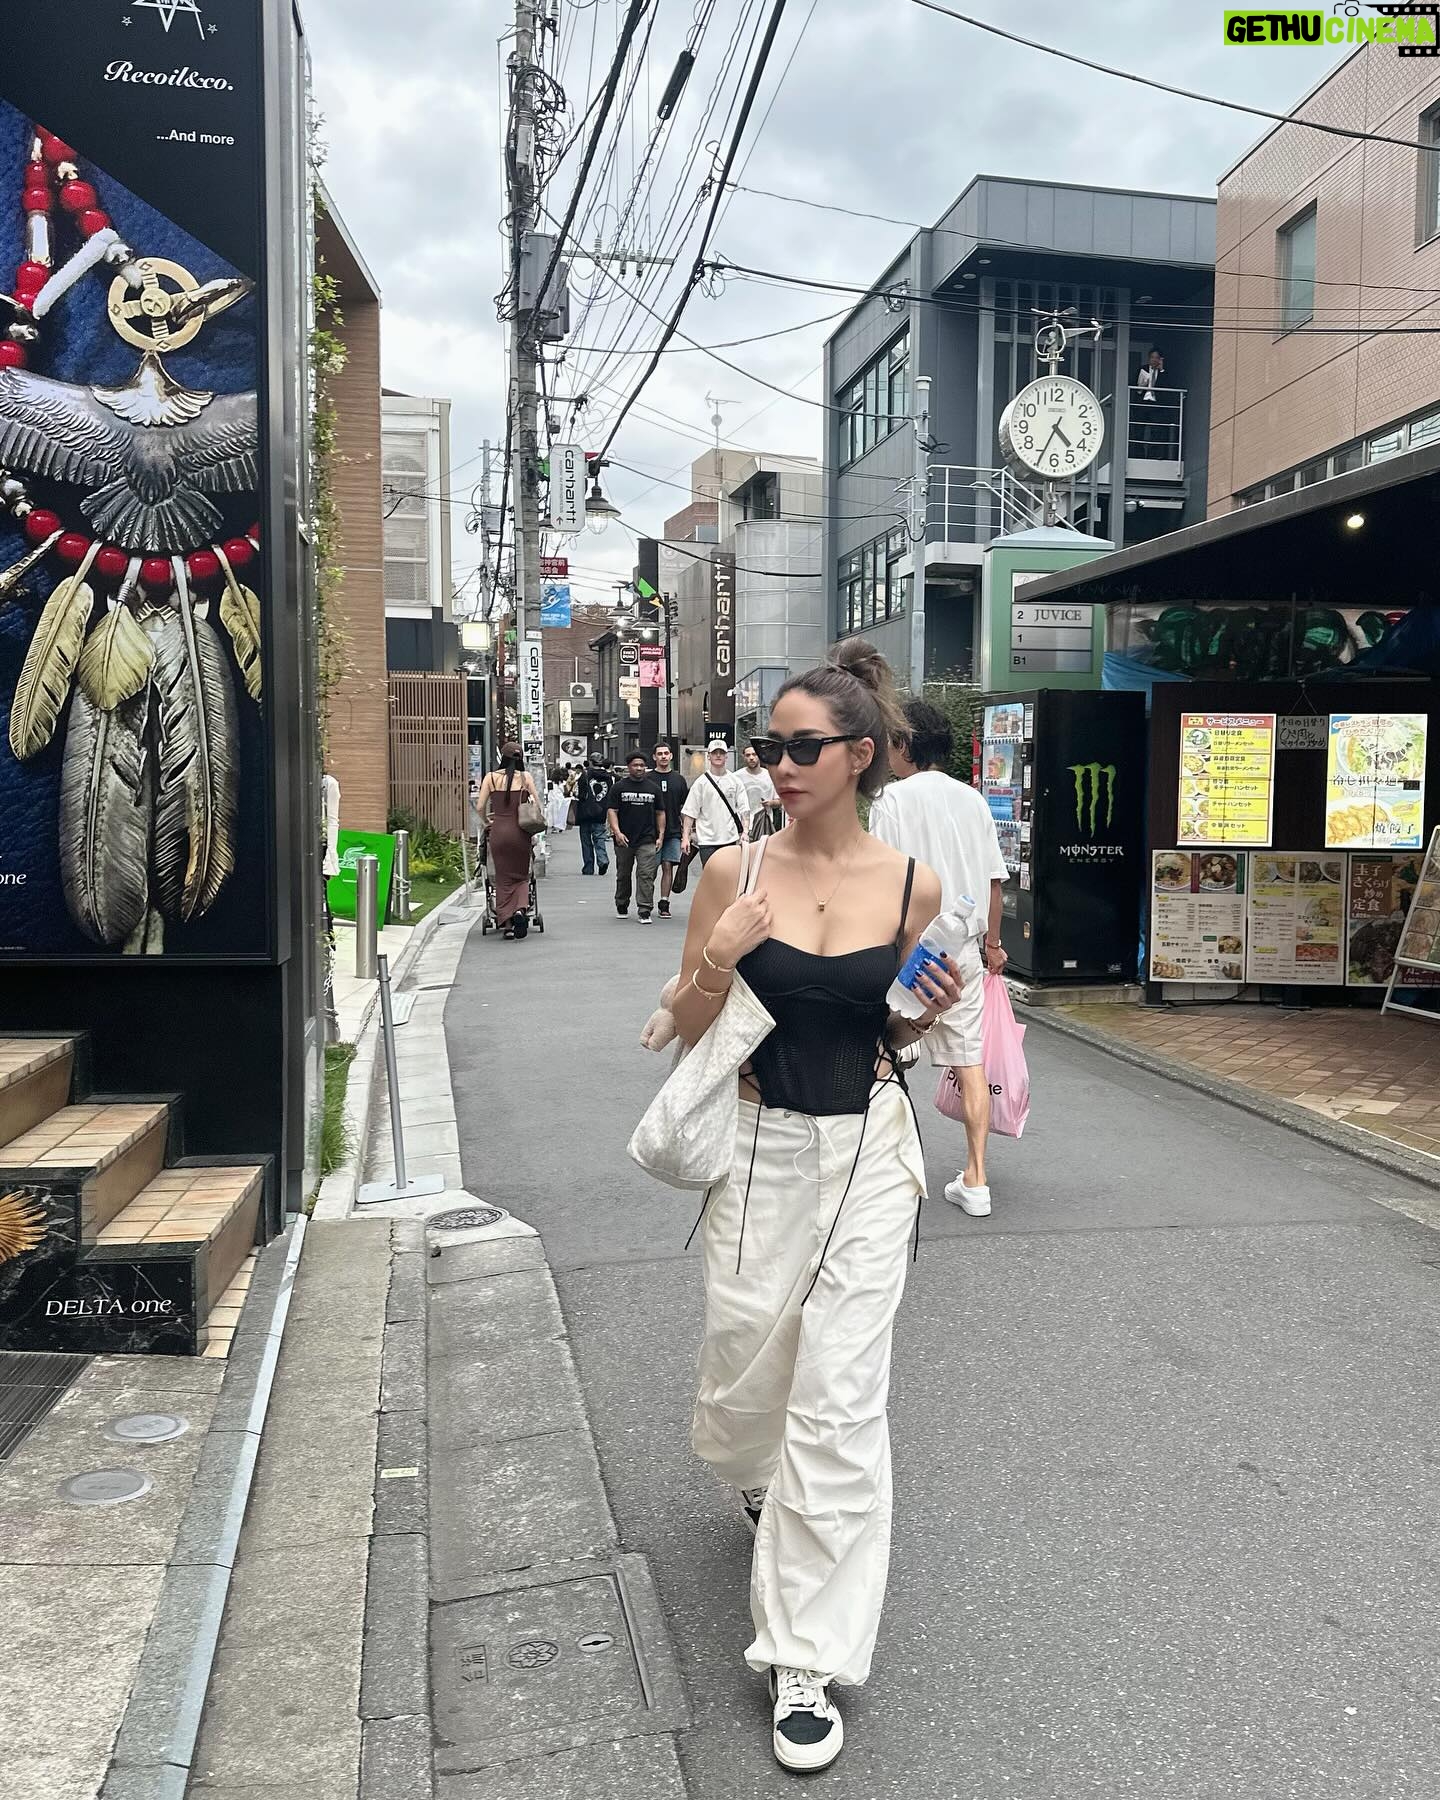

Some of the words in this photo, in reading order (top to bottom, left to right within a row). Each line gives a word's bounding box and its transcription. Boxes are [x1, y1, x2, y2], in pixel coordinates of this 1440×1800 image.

[103, 60, 234, 91] Recoil&co.
[199, 133, 235, 145] more
[1037, 391, 1047, 405] 11
[1050, 388, 1064, 402] 12
[1023, 403, 1037, 417] 10
[1078, 404, 1088, 418] 2
[1018, 419, 1029, 434] 9
[1082, 421, 1092, 436] 3
[1023, 435, 1034, 449] 8
[1076, 438, 1087, 452] 4
[1049, 453, 1059, 468] 6
[1065, 449, 1075, 463] 5
[565, 449, 577, 524] carhartt
[714, 558, 731, 677] carhartt
[1017, 610, 1024, 620] 2
[1034, 609, 1082, 622] JUVICE
[1017, 634, 1023, 642] 1
[1013, 656, 1026, 665] B1
[530, 647, 541, 726] carhartt
[709, 731, 727, 740] HUF
[1059, 844, 1125, 857] MONSTER
[1352, 898, 1381, 911] 定食
[45, 1298, 125, 1316] DELTA
[131, 1299, 172, 1314] one
